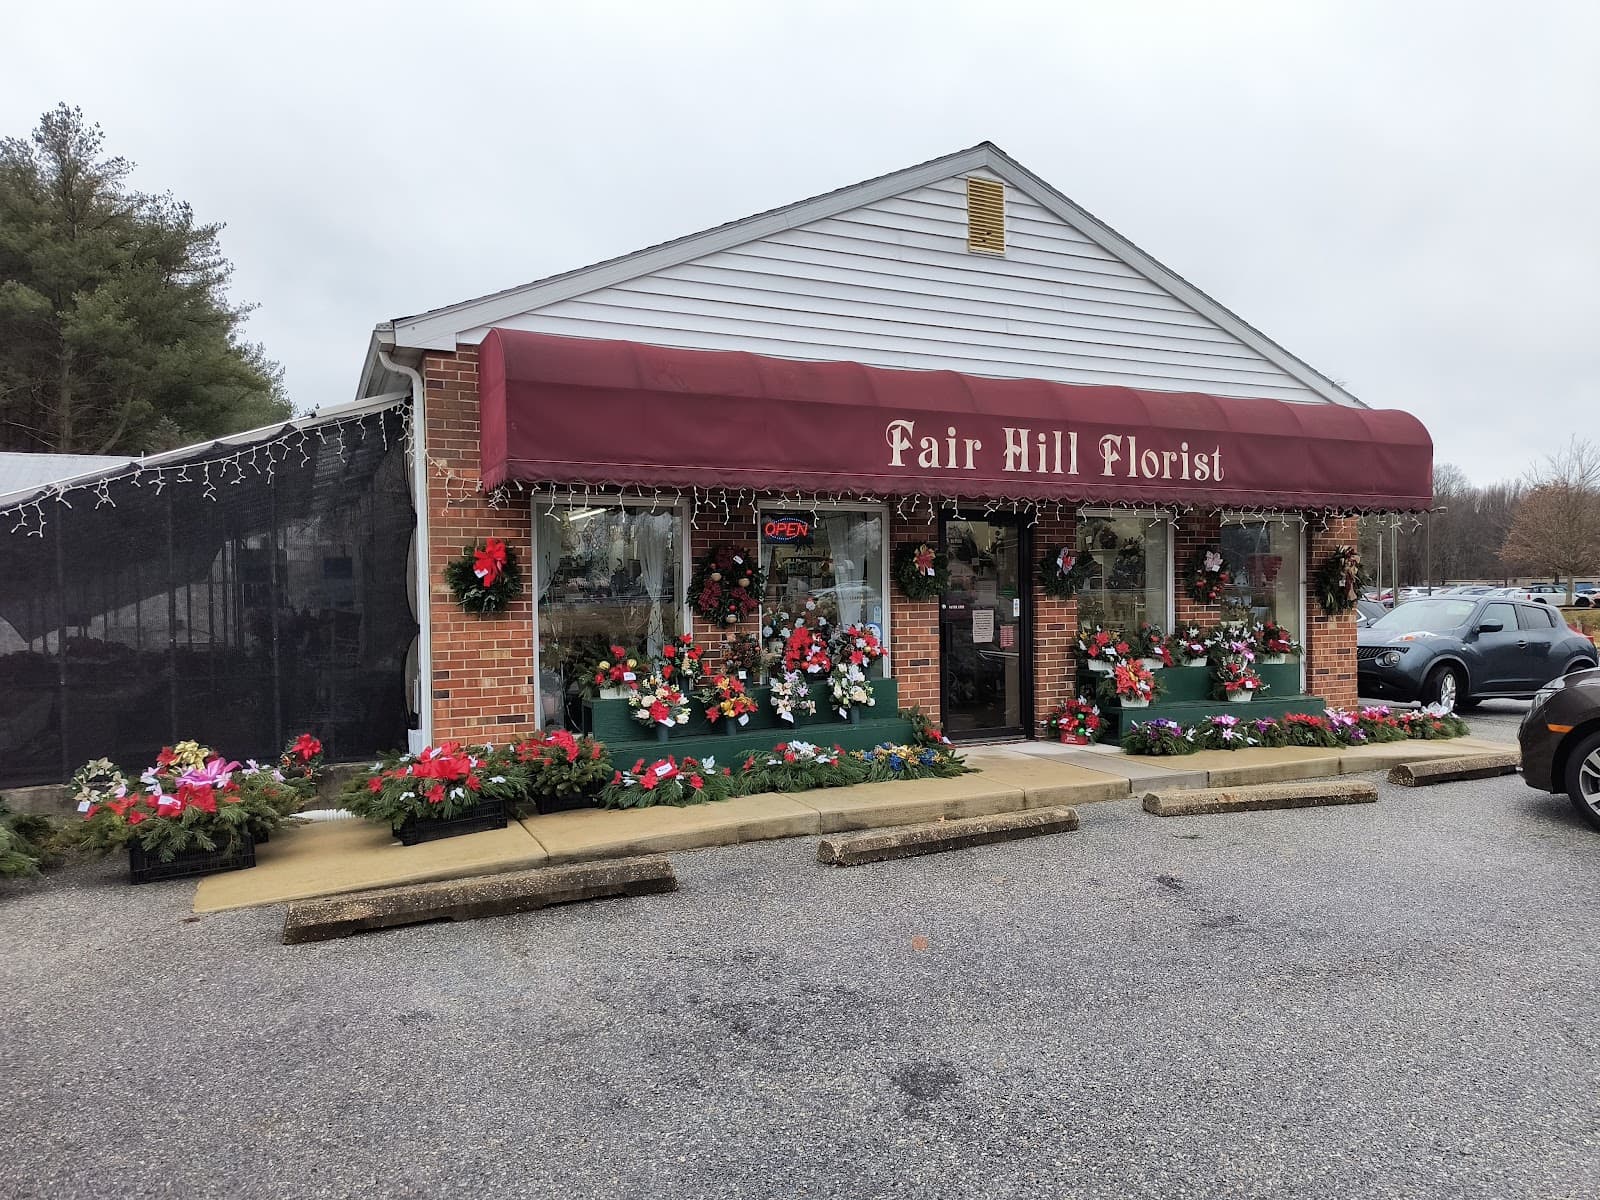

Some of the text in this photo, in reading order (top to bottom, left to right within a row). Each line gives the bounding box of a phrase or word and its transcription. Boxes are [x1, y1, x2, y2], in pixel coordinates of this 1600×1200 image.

[885, 419, 1225, 482] Fair Hill Florist
[765, 522, 809, 537] OPEN
